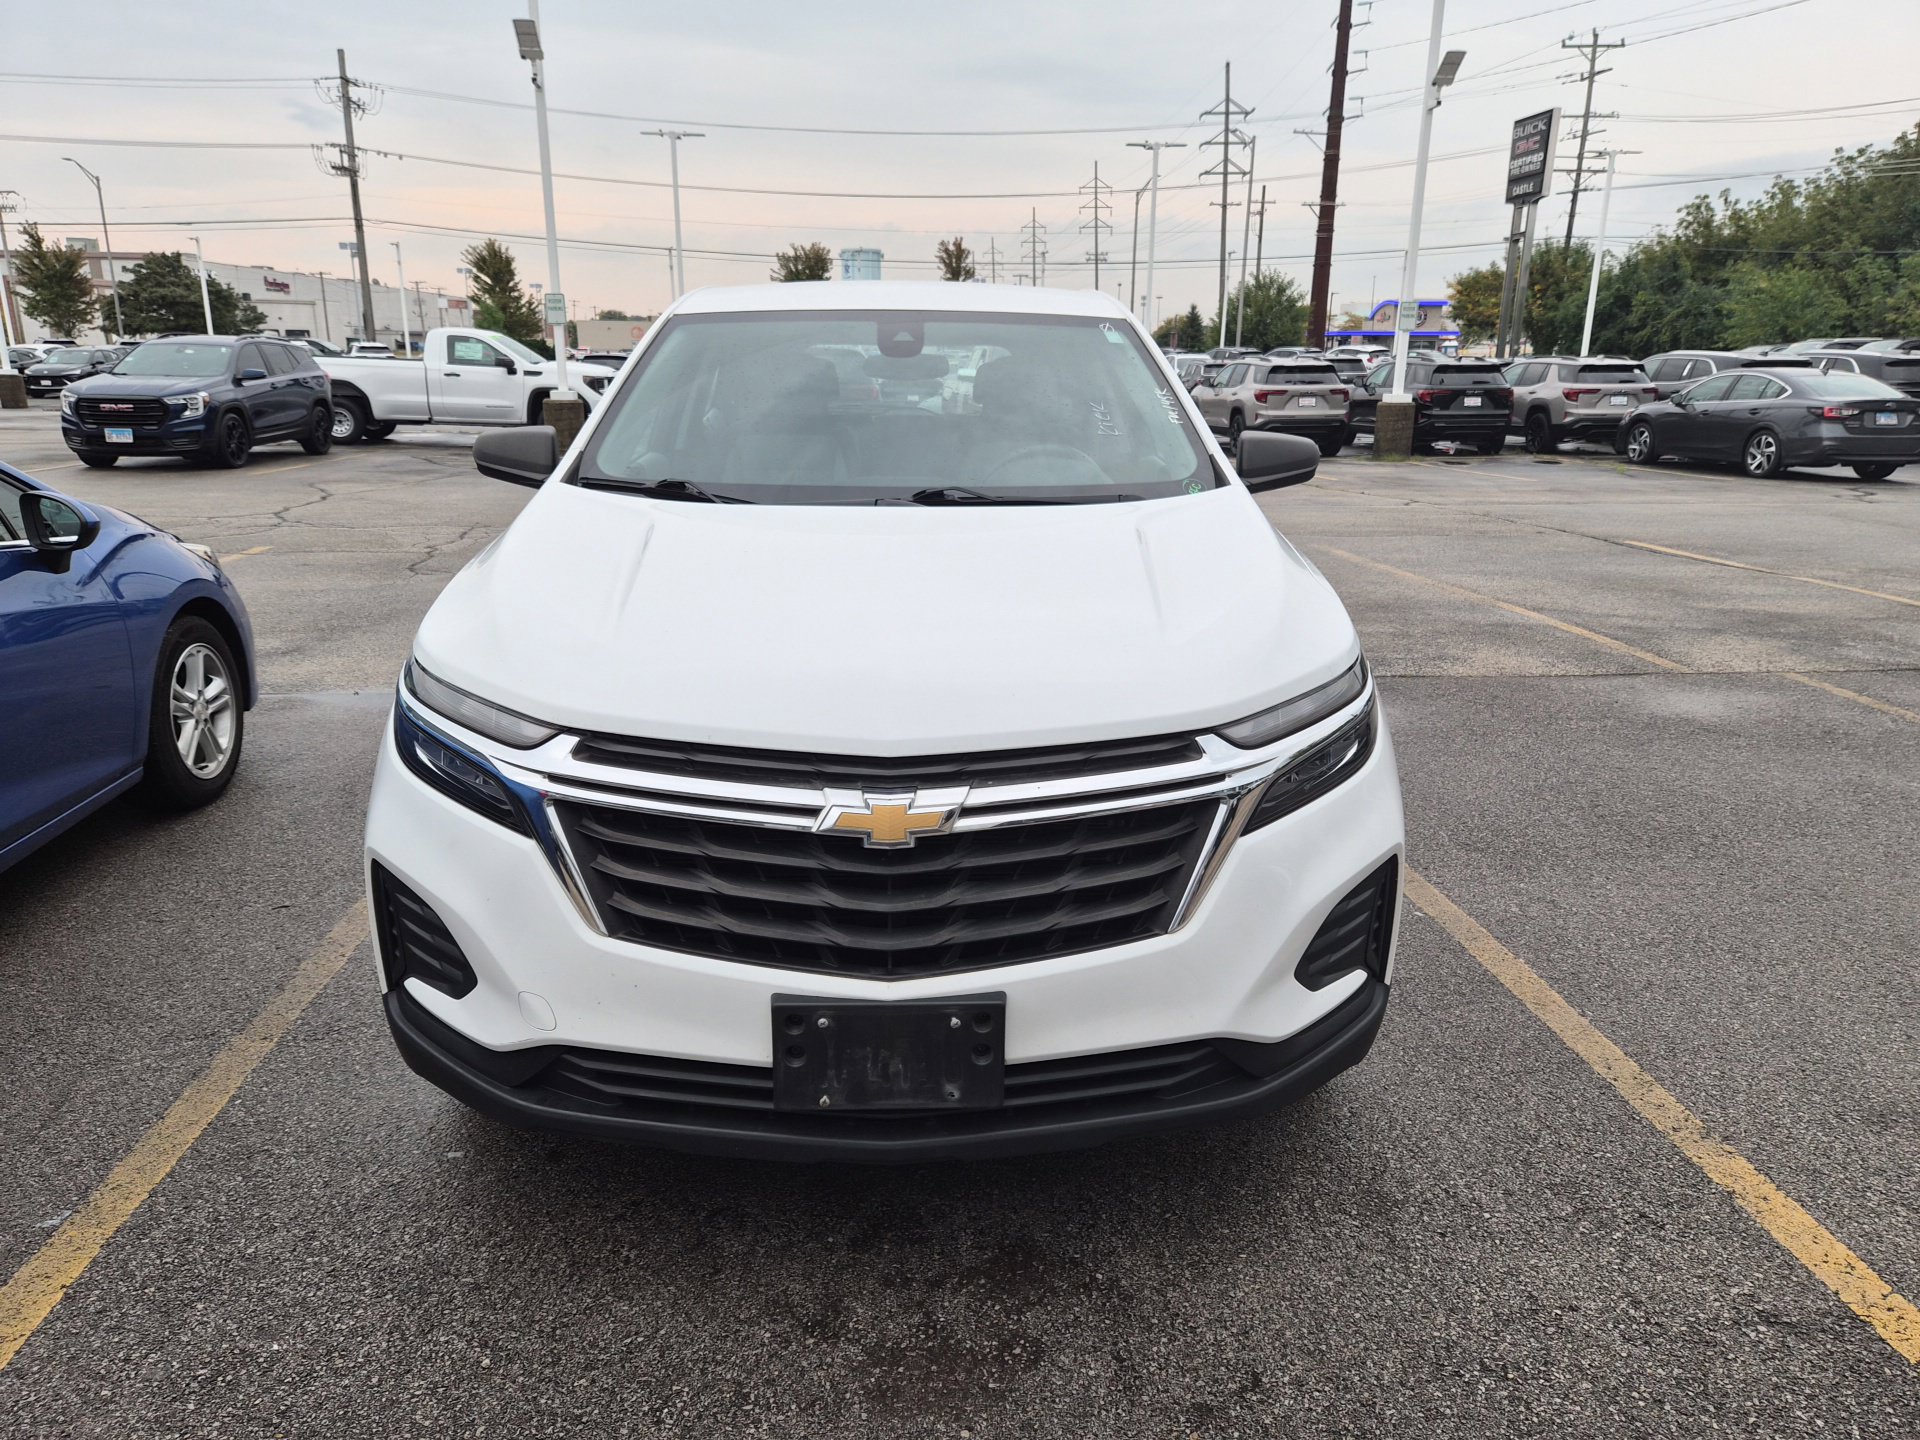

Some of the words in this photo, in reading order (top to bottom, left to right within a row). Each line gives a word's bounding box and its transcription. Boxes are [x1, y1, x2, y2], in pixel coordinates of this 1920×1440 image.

[1513, 119, 1549, 139] BUICK
[1515, 136, 1541, 155] GMC
[1510, 152, 1545, 170] CERTIFIED
[1512, 181, 1535, 197] CASTLE
[99, 404, 134, 412] GMC
